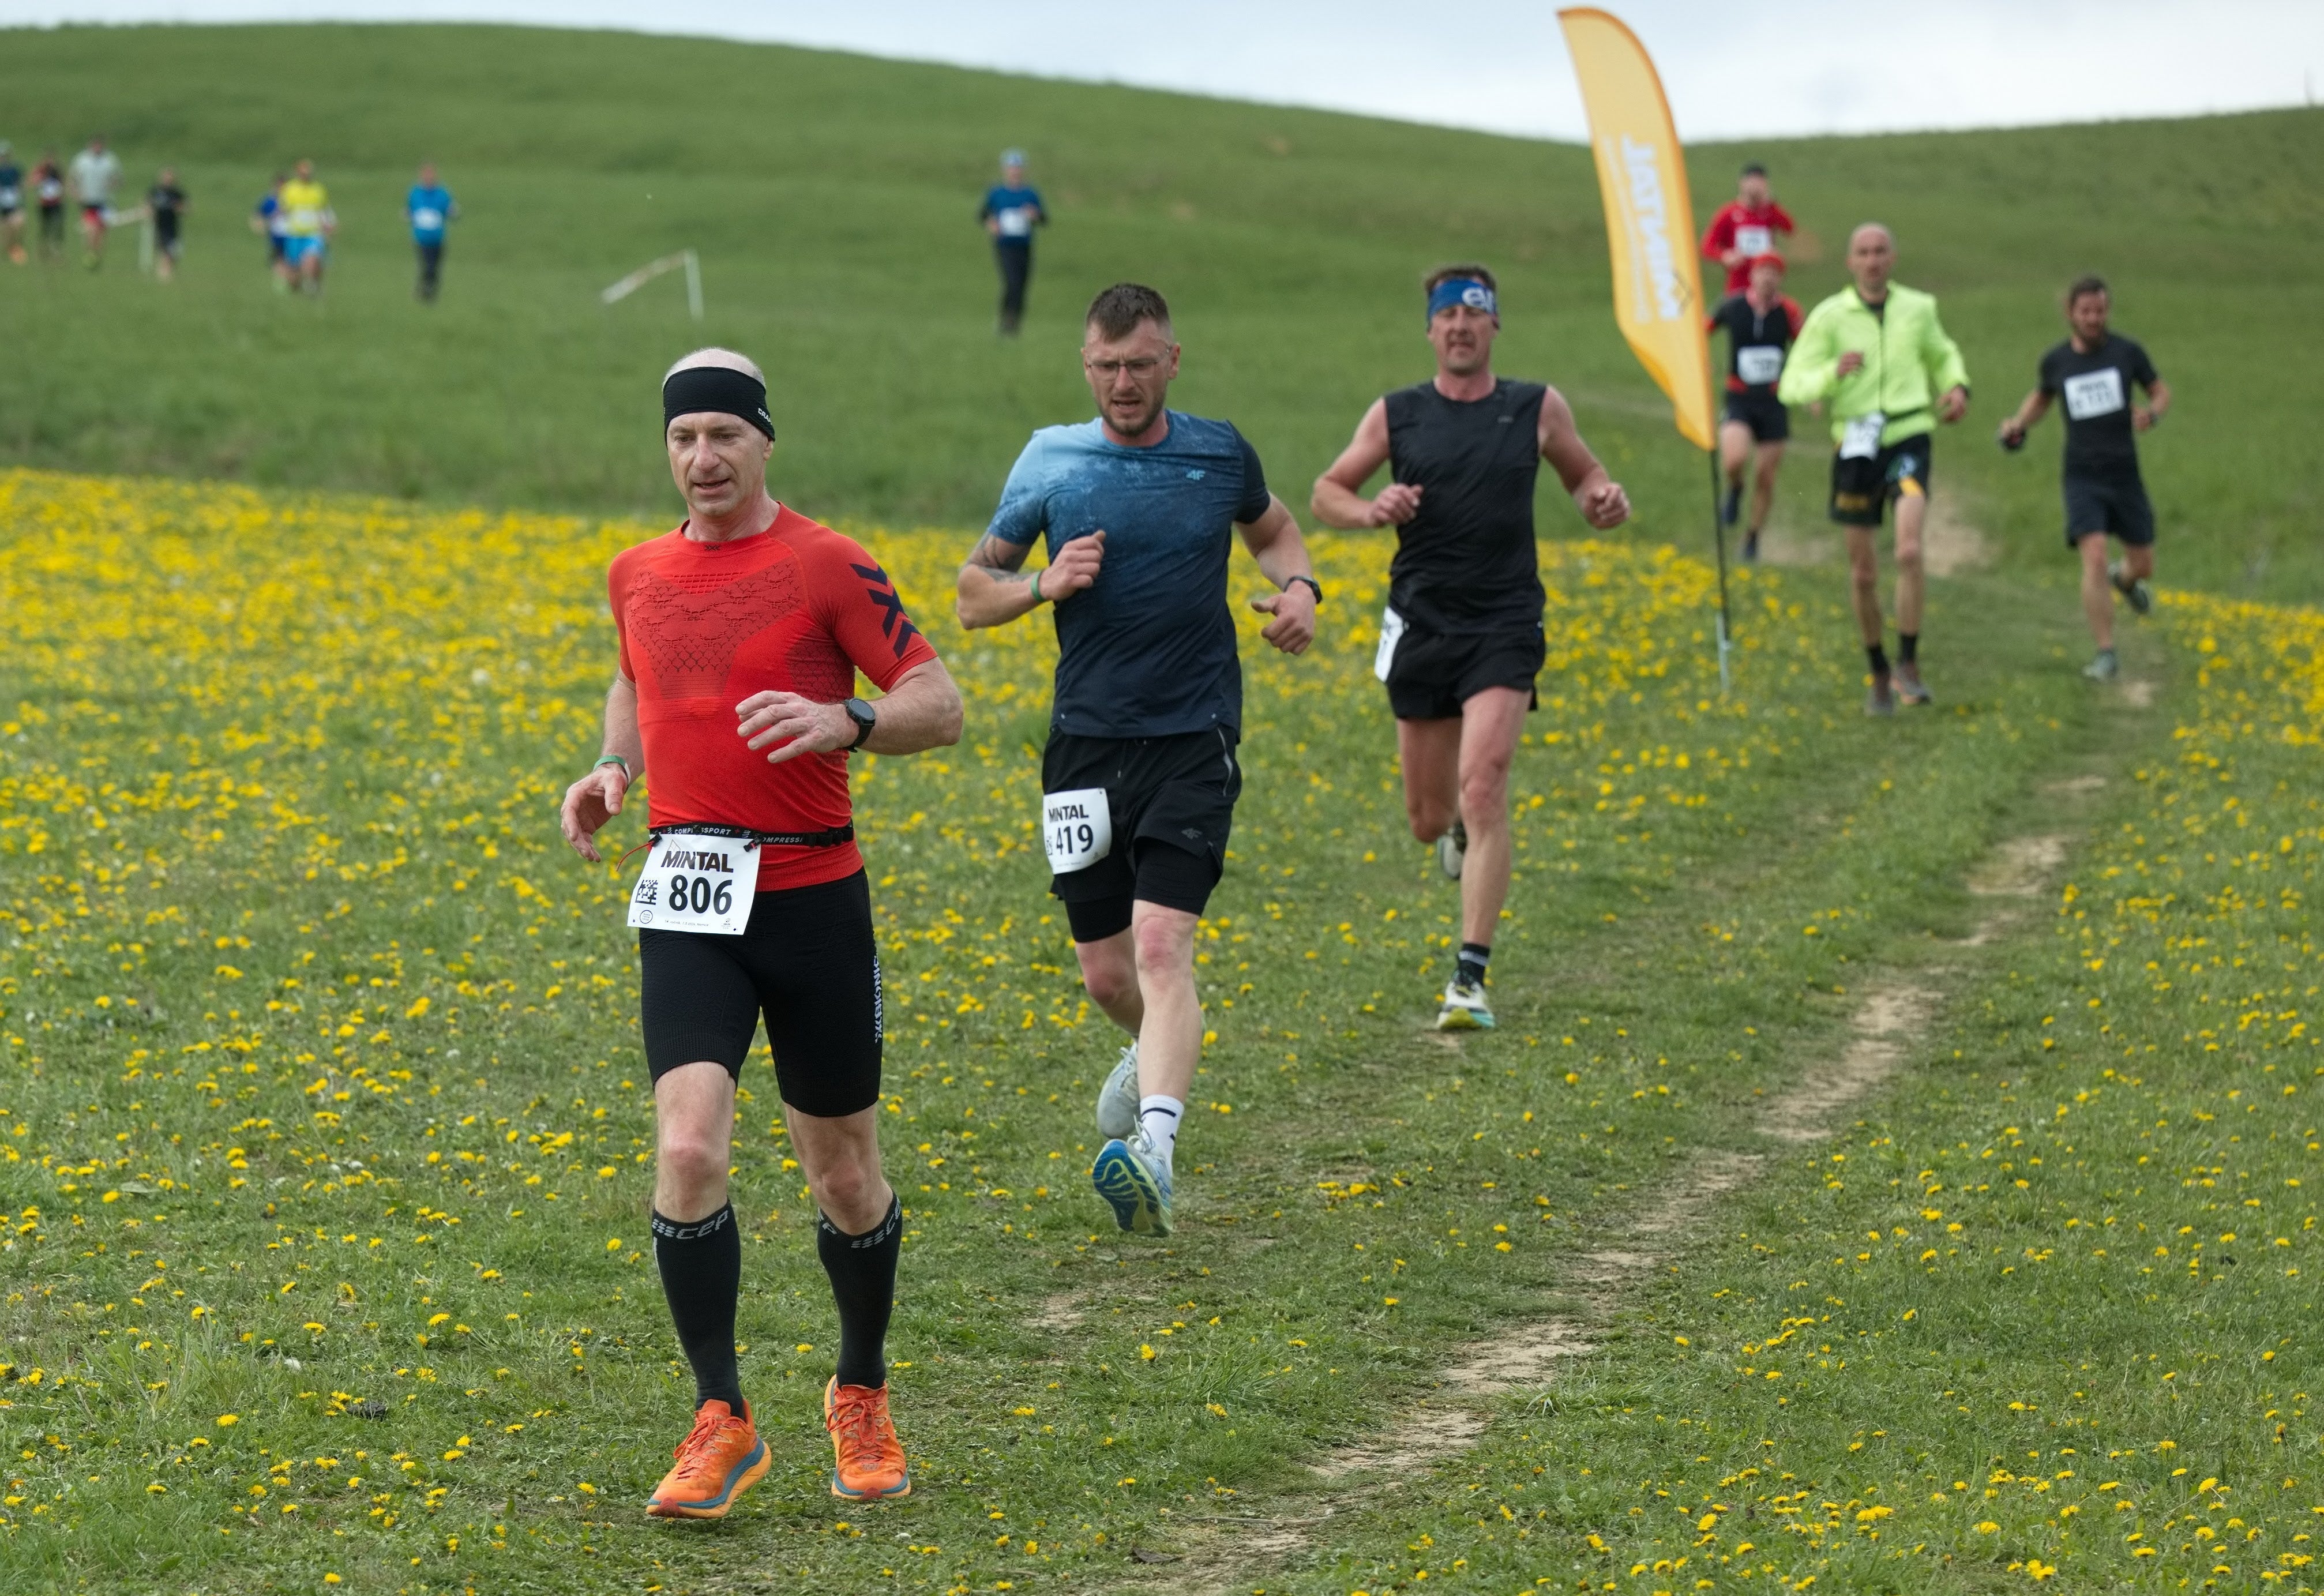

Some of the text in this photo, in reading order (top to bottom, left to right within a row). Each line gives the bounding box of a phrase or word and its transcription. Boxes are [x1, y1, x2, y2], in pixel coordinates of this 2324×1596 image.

[758, 407, 772, 425] CRA
[1186, 470, 1206, 480] 4F
[1056, 824, 1094, 855] 419
[660, 850, 734, 873] MINTAL
[669, 874, 733, 915] 806
